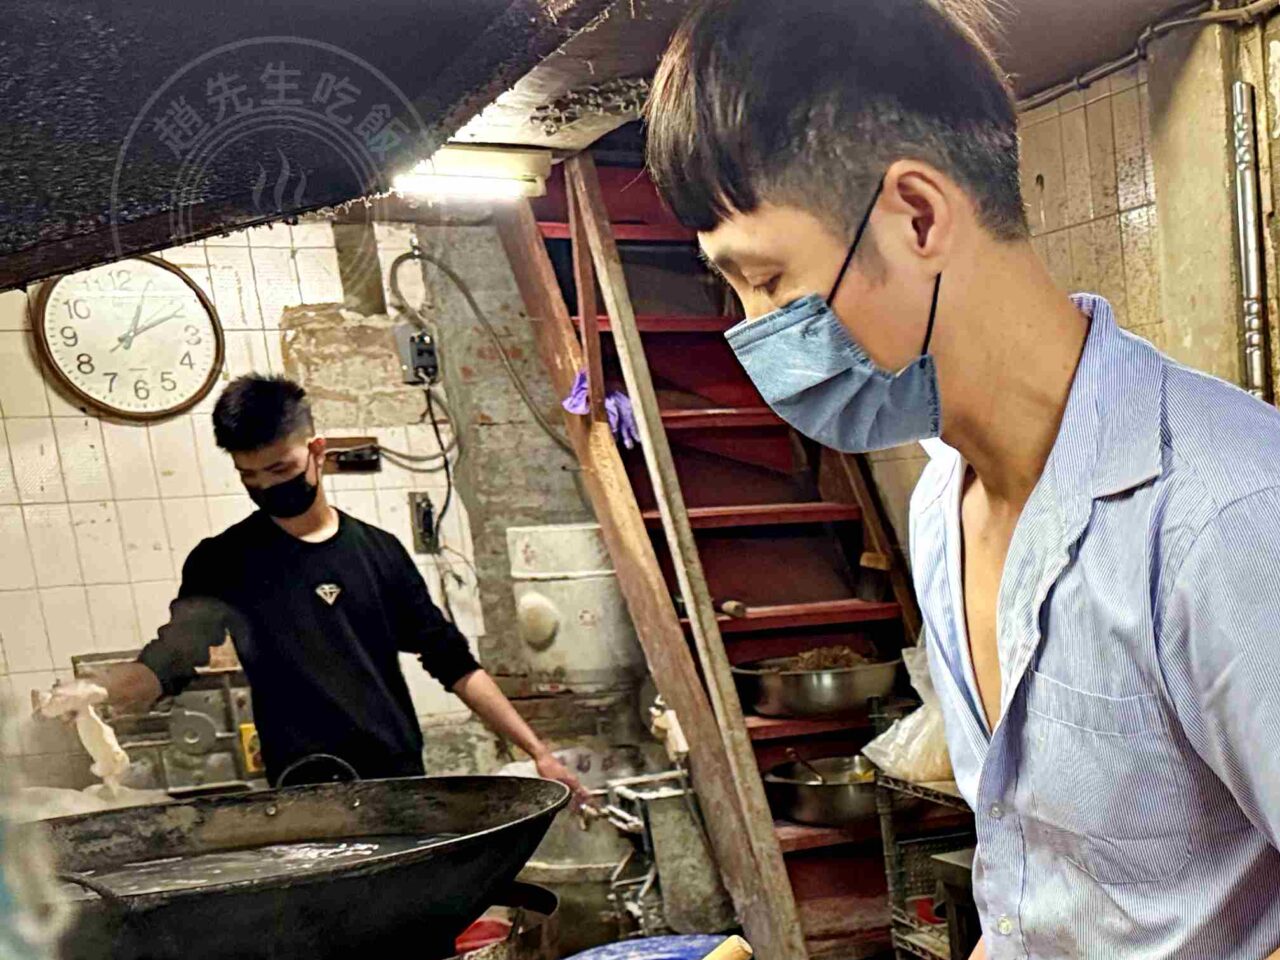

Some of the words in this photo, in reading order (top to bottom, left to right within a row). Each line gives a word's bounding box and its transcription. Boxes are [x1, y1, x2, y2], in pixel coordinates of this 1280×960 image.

[108, 270, 132, 291] 12
[63, 299, 91, 320] 10
[60, 326, 78, 347] 9
[184, 325, 202, 345] 3
[76, 353, 95, 375] 8
[179, 351, 195, 370] 4
[103, 372, 118, 393] 7
[134, 380, 150, 400] 6
[160, 372, 177, 391] 5
